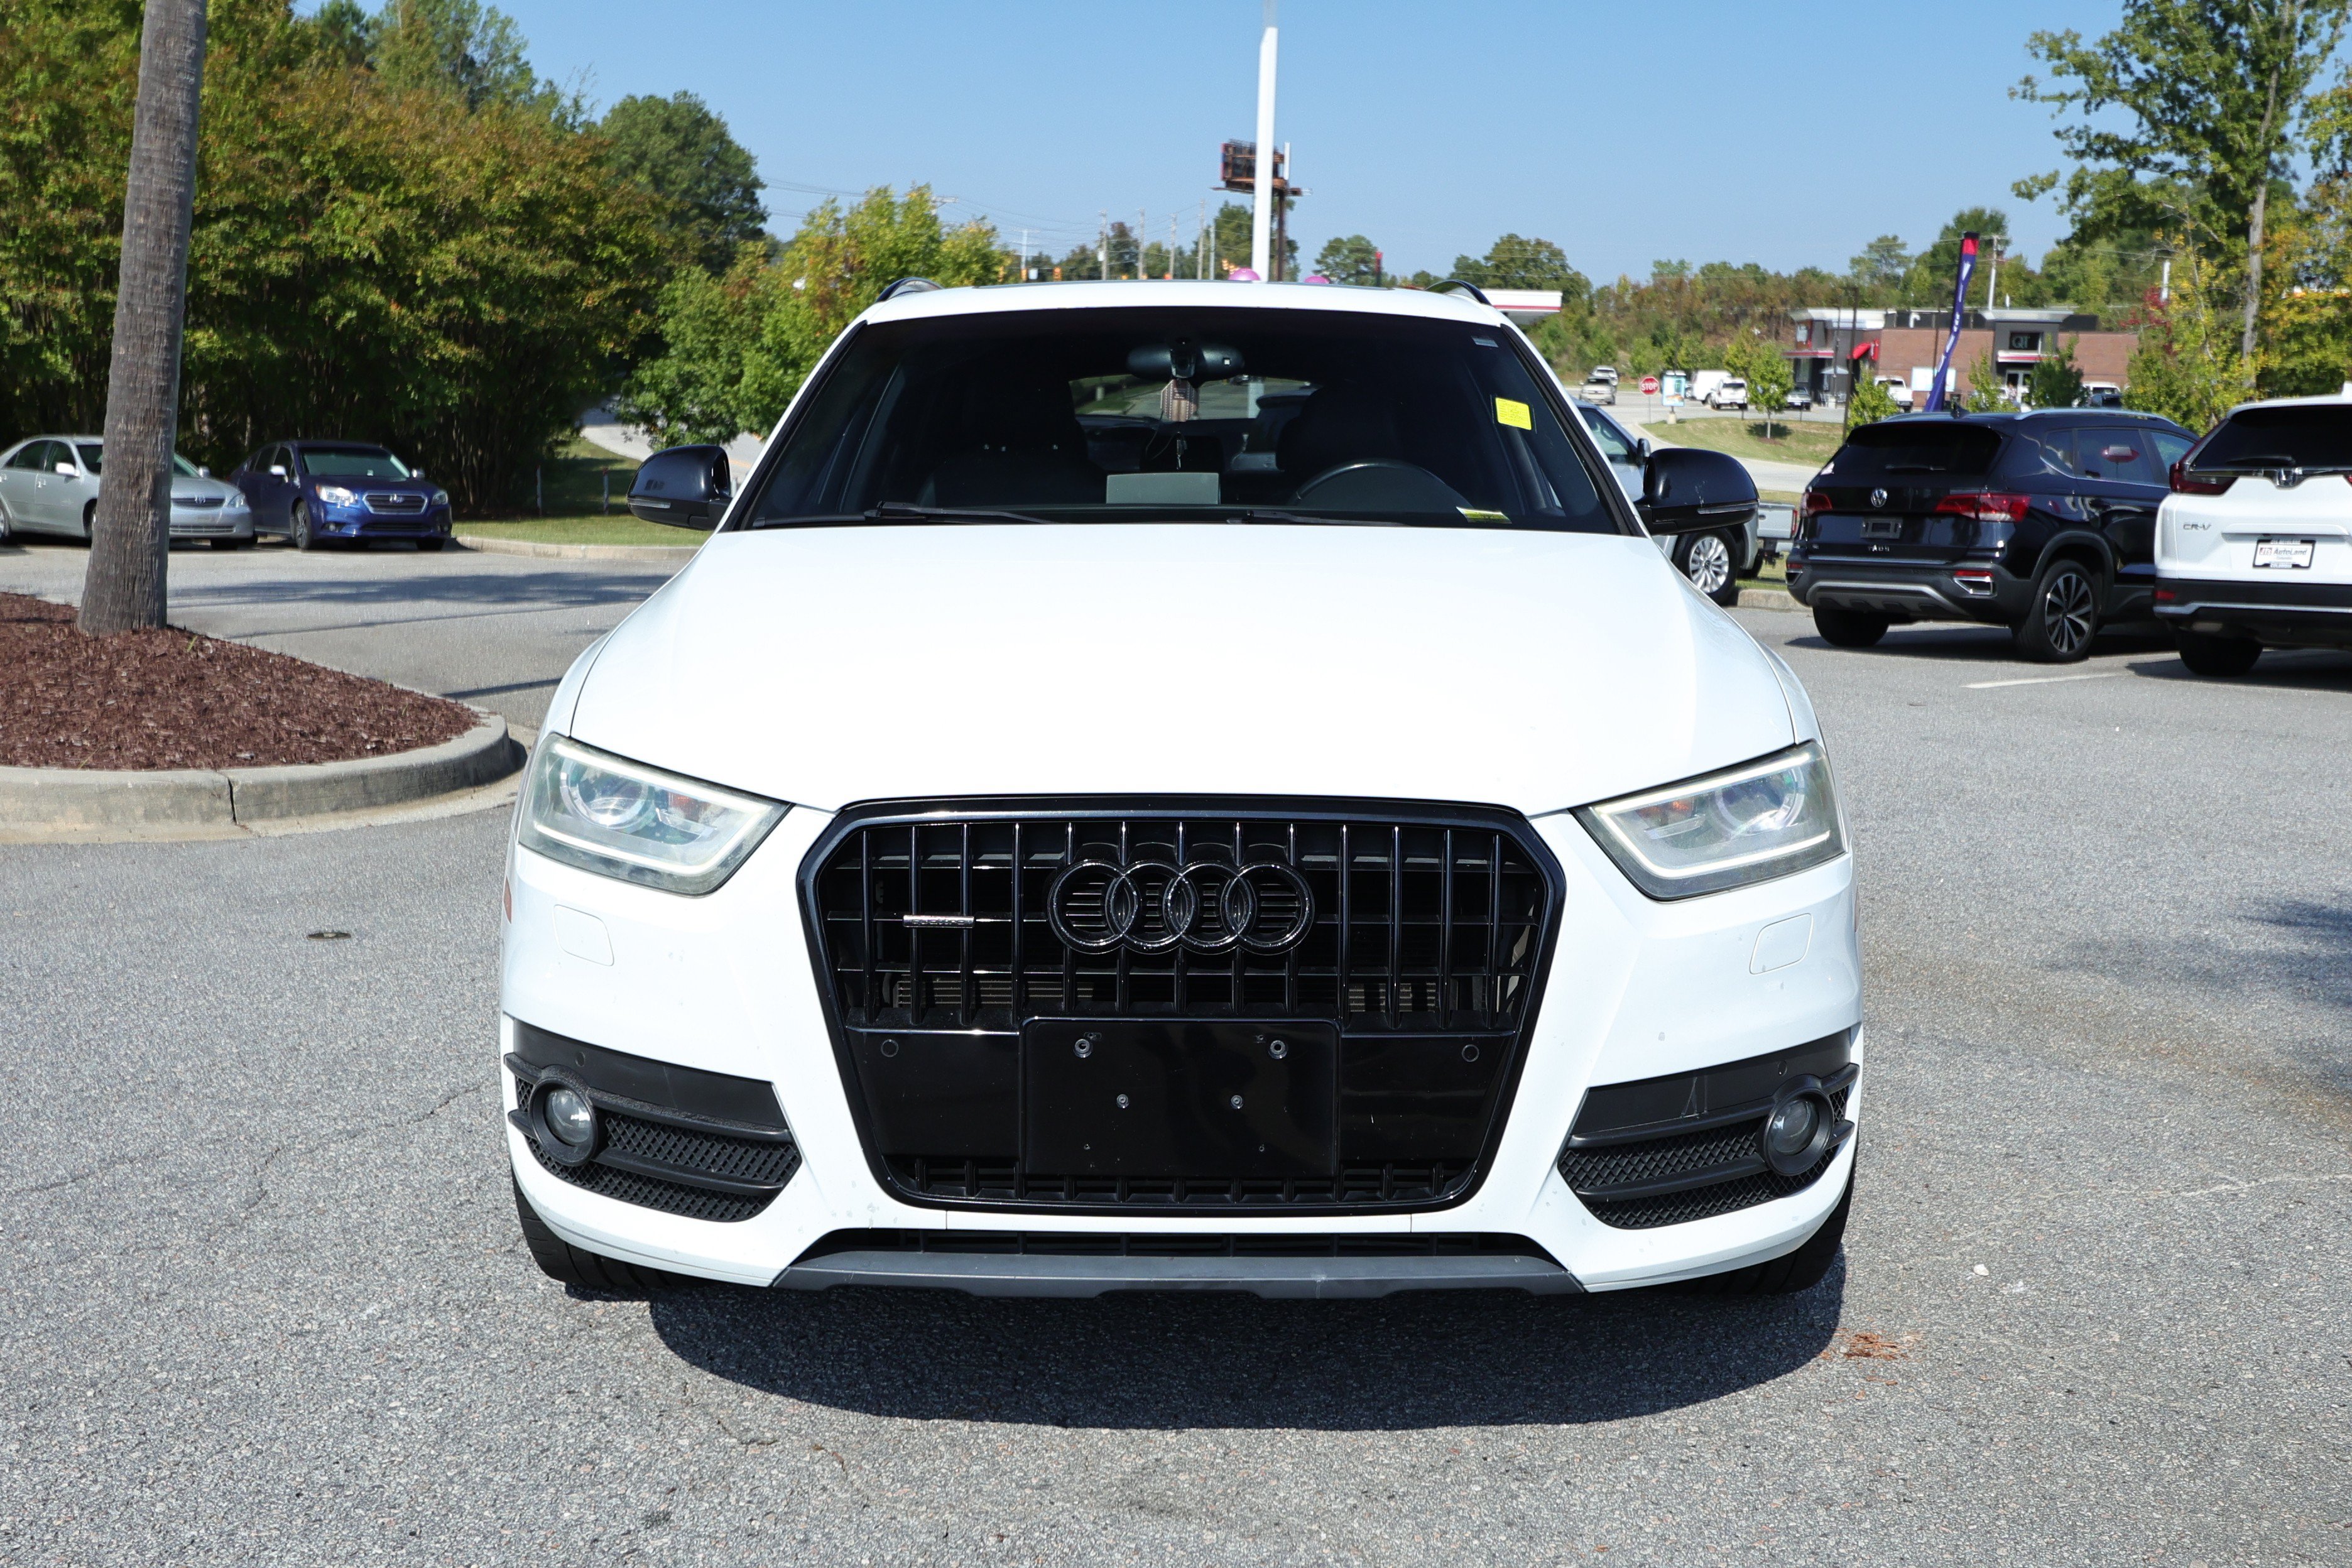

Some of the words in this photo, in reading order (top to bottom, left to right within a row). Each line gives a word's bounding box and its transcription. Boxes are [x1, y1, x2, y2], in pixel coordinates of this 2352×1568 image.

[2012, 335, 2031, 349] QT
[1641, 383, 1658, 391] STOP
[2273, 547, 2308, 555] AutoLand
